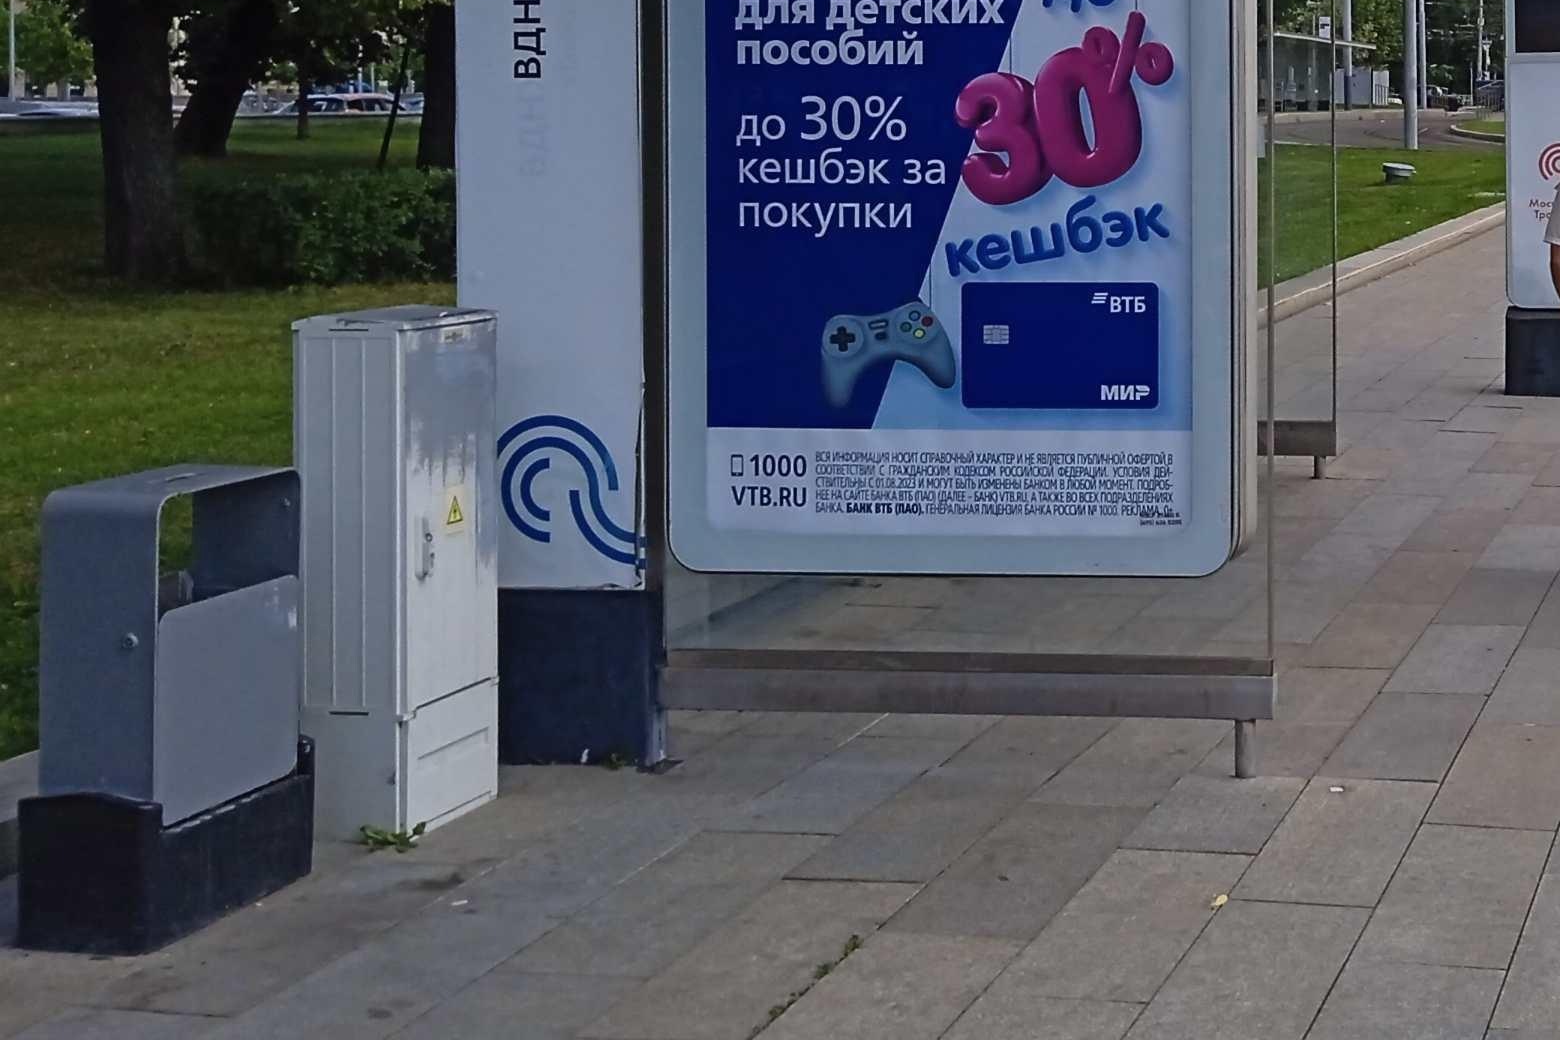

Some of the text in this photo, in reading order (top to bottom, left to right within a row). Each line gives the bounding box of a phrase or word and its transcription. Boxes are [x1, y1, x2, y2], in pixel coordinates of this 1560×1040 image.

[737, 28, 924, 65] пособий
[736, 95, 907, 146] до 30%
[955, 9, 1175, 206] 30%
[739, 147, 946, 185] кешбэк за
[739, 201, 912, 238] покупки
[944, 194, 1171, 278] кешбэк
[1110, 296, 1147, 313] ВТБ
[1100, 384, 1151, 401] МИР
[749, 454, 807, 477] 1000
[892, 452, 918, 464] НОСИТ
[731, 486, 807, 508] VTB.RU
[846, 502, 873, 514] БАНК
[875, 502, 893, 514] ВТБ
[894, 502, 925, 516] (ПАО).
